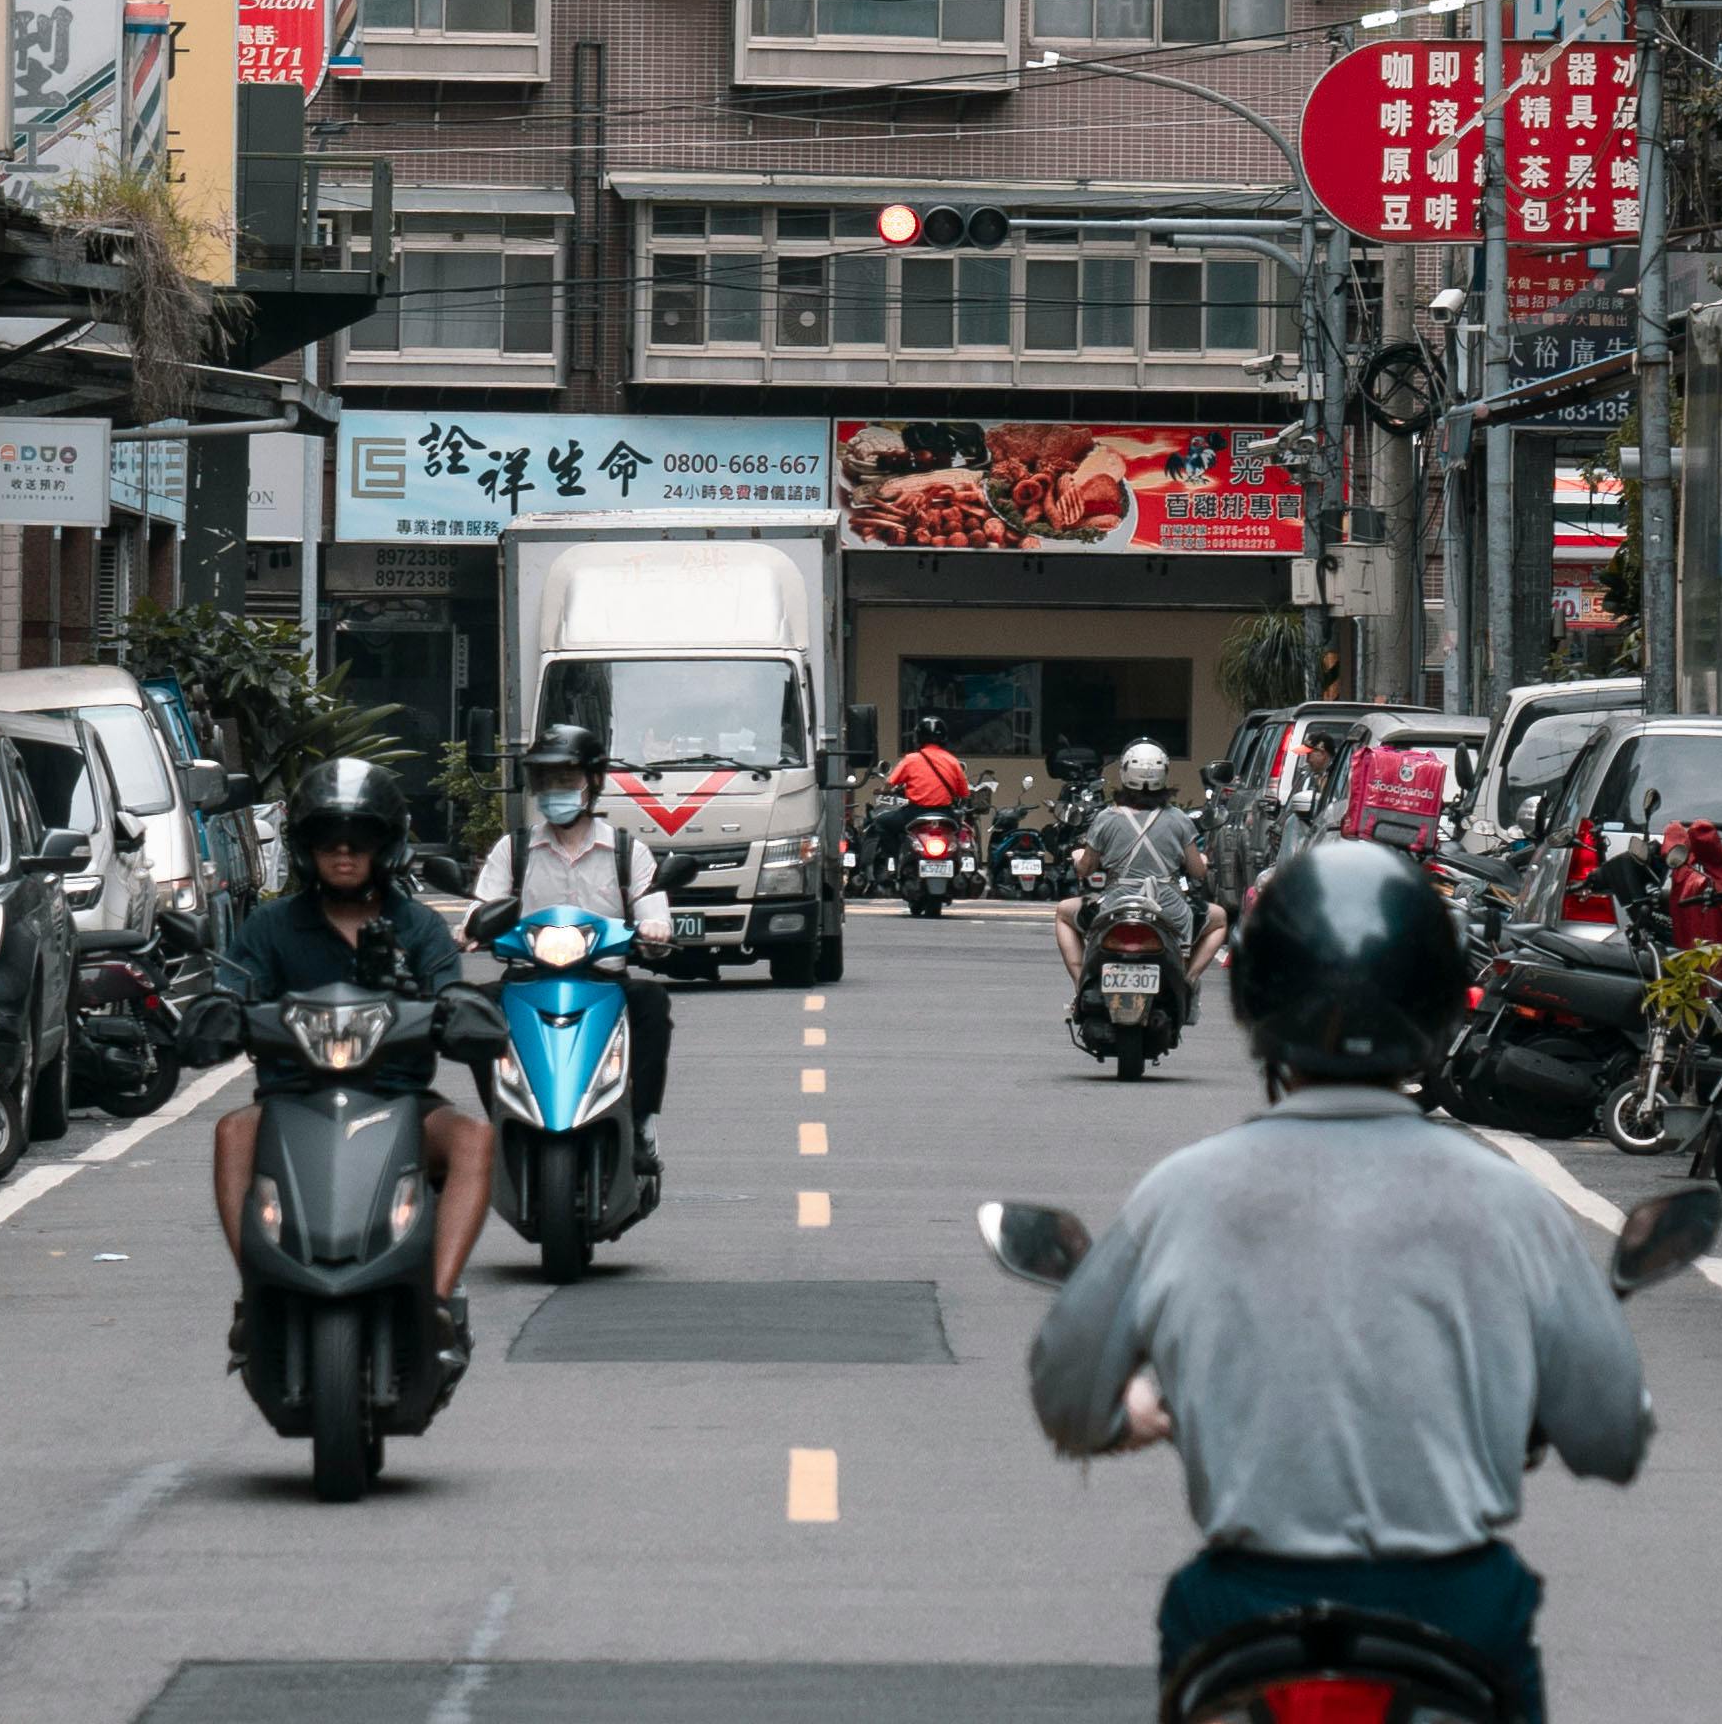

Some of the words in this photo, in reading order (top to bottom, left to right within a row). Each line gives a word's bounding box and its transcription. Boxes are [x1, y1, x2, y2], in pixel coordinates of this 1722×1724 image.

[1380, 50, 1414, 232] 咖啡原豆
[1424, 50, 1461, 231] 即溶咖啡
[662, 451, 821, 476] 0800-668-667
[1369, 778, 1435, 800] foodpanda
[1103, 974, 1159, 990] CXZ-307
